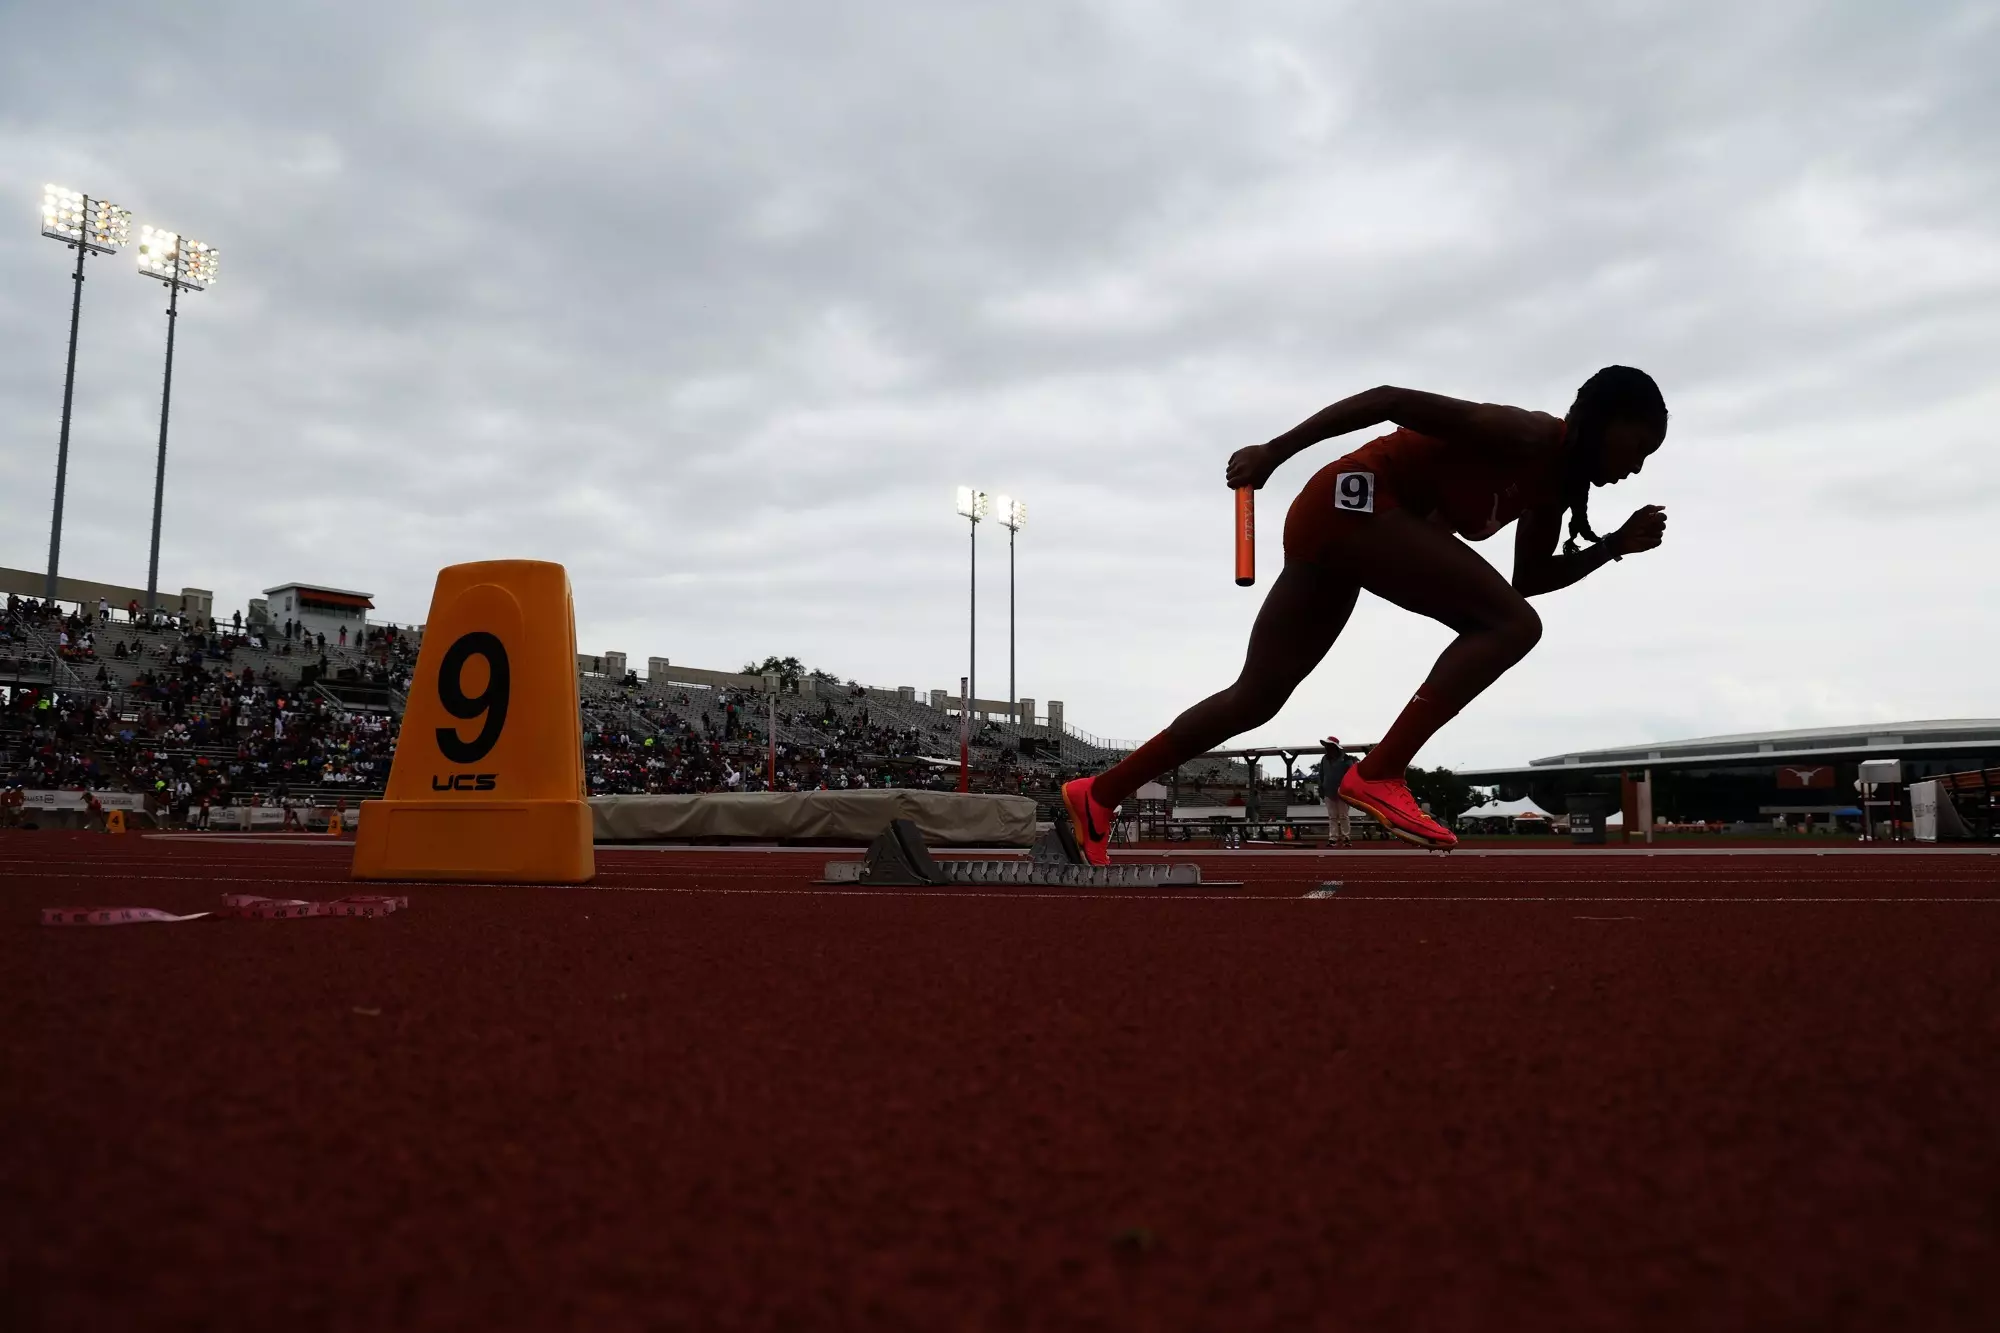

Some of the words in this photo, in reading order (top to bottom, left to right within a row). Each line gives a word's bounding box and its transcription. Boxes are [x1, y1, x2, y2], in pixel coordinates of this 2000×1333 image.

[1341, 474, 1369, 509] 9
[435, 631, 510, 764] 9
[432, 774, 500, 791] UCS
[111, 815, 120, 826] 4
